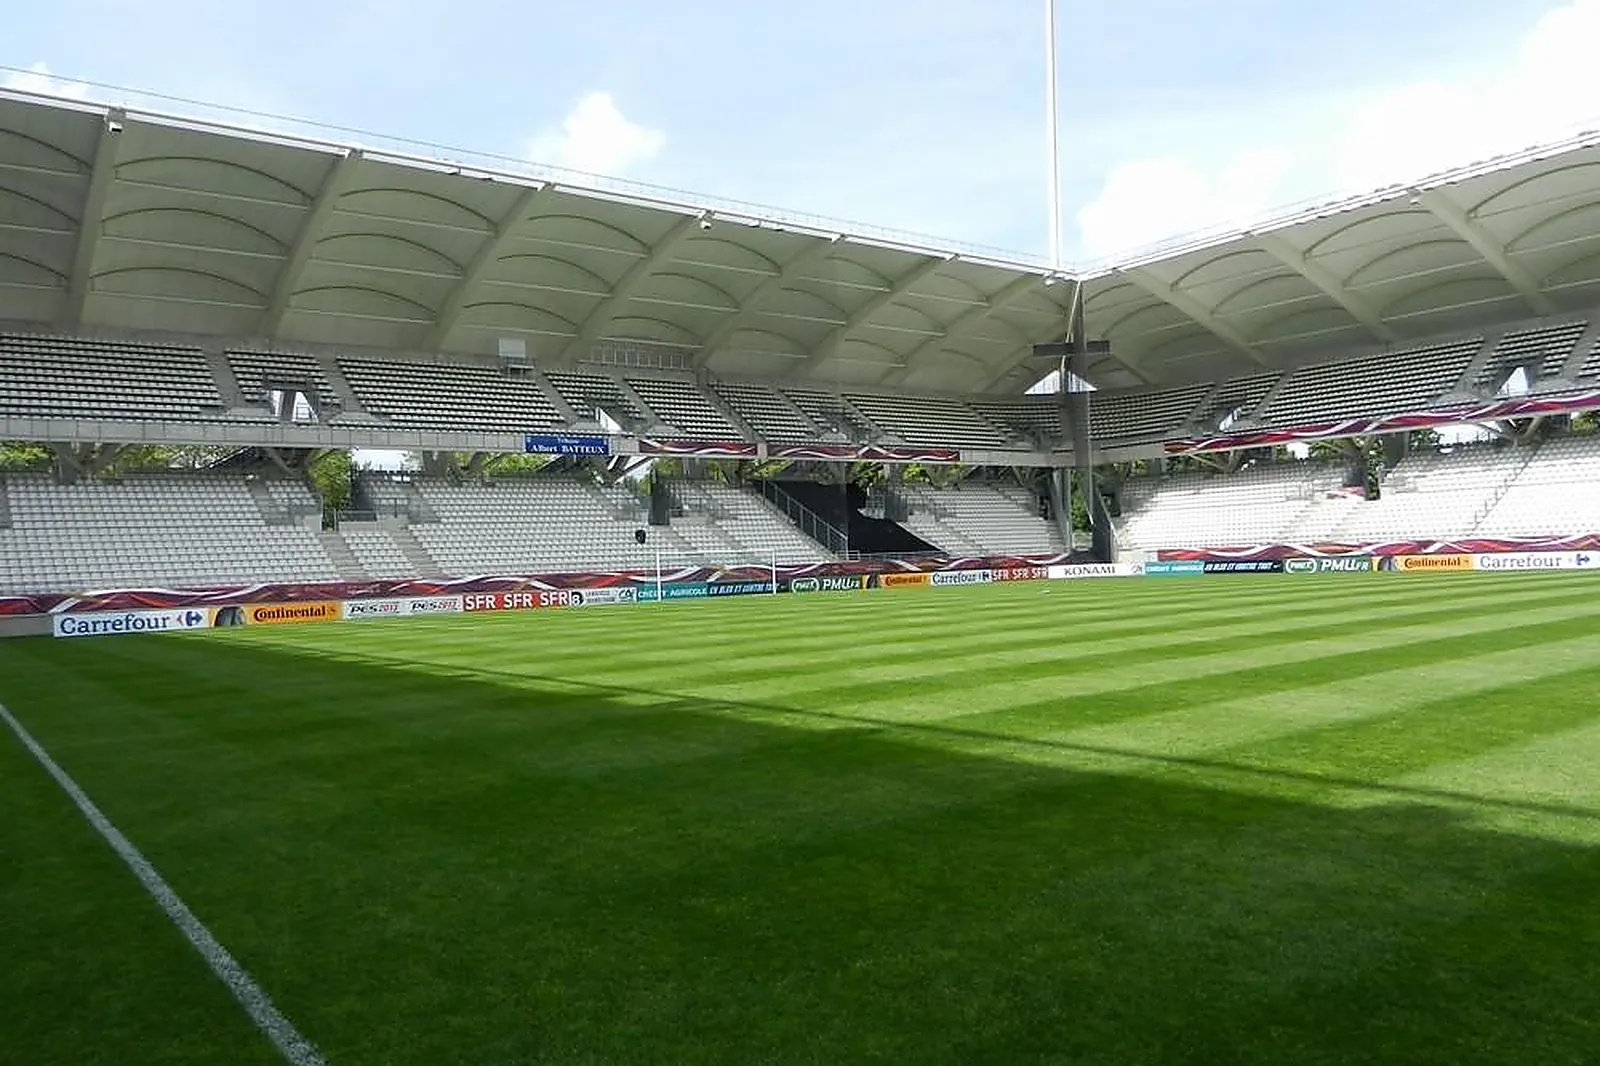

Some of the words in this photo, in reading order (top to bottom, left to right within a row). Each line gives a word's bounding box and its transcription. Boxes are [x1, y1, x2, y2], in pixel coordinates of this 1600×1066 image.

[561, 445, 605, 454] BATTEUX
[1404, 557, 1461, 569] Continental
[1480, 554, 1562, 568] Carrefour
[993, 571, 1009, 580] SFR
[1013, 569, 1028, 579] SFR
[1064, 565, 1116, 576] KONAMI
[932, 572, 977, 584] Carrefour
[465, 596, 496, 610] SFR
[503, 594, 532, 608] SFR
[540, 591, 568, 606] SFR
[254, 605, 325, 622] Continental
[60, 614, 170, 634] Carrefour
